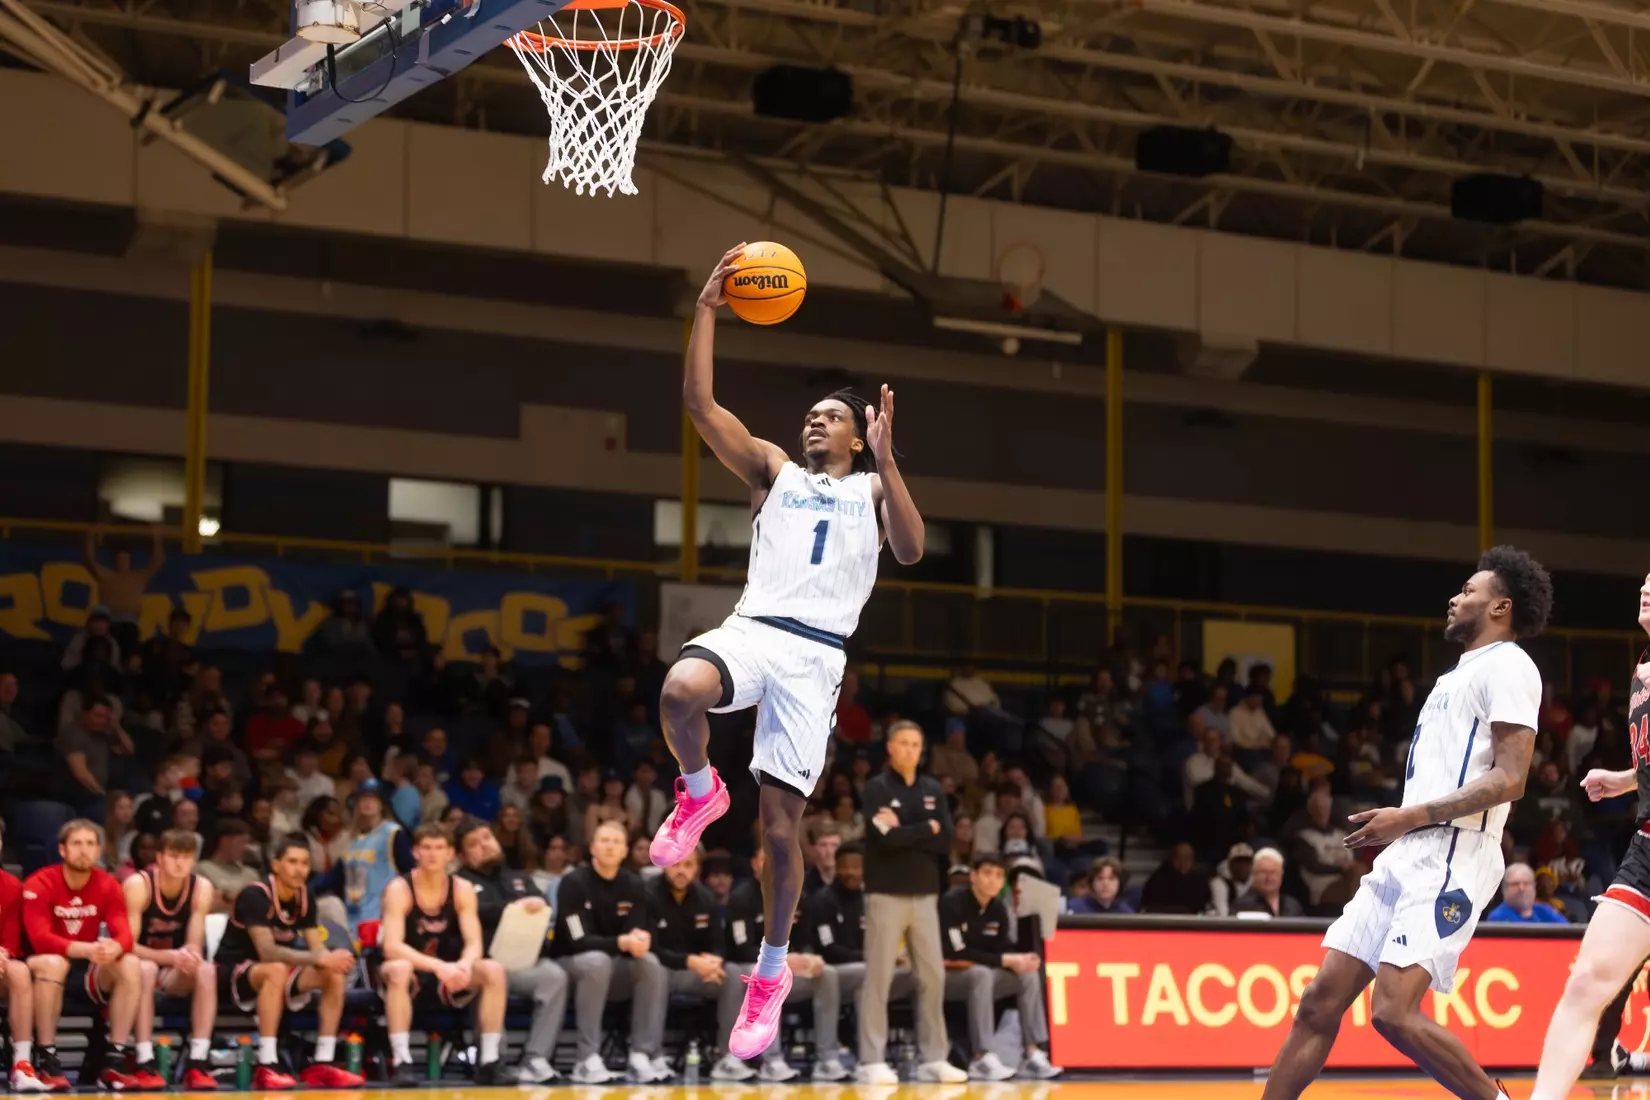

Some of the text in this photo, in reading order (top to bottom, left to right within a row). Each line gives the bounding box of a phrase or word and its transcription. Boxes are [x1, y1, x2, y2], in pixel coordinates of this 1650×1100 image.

[733, 274, 789, 290] Wilson
[810, 519, 829, 565] 1
[1429, 967, 1522, 1029] KC
